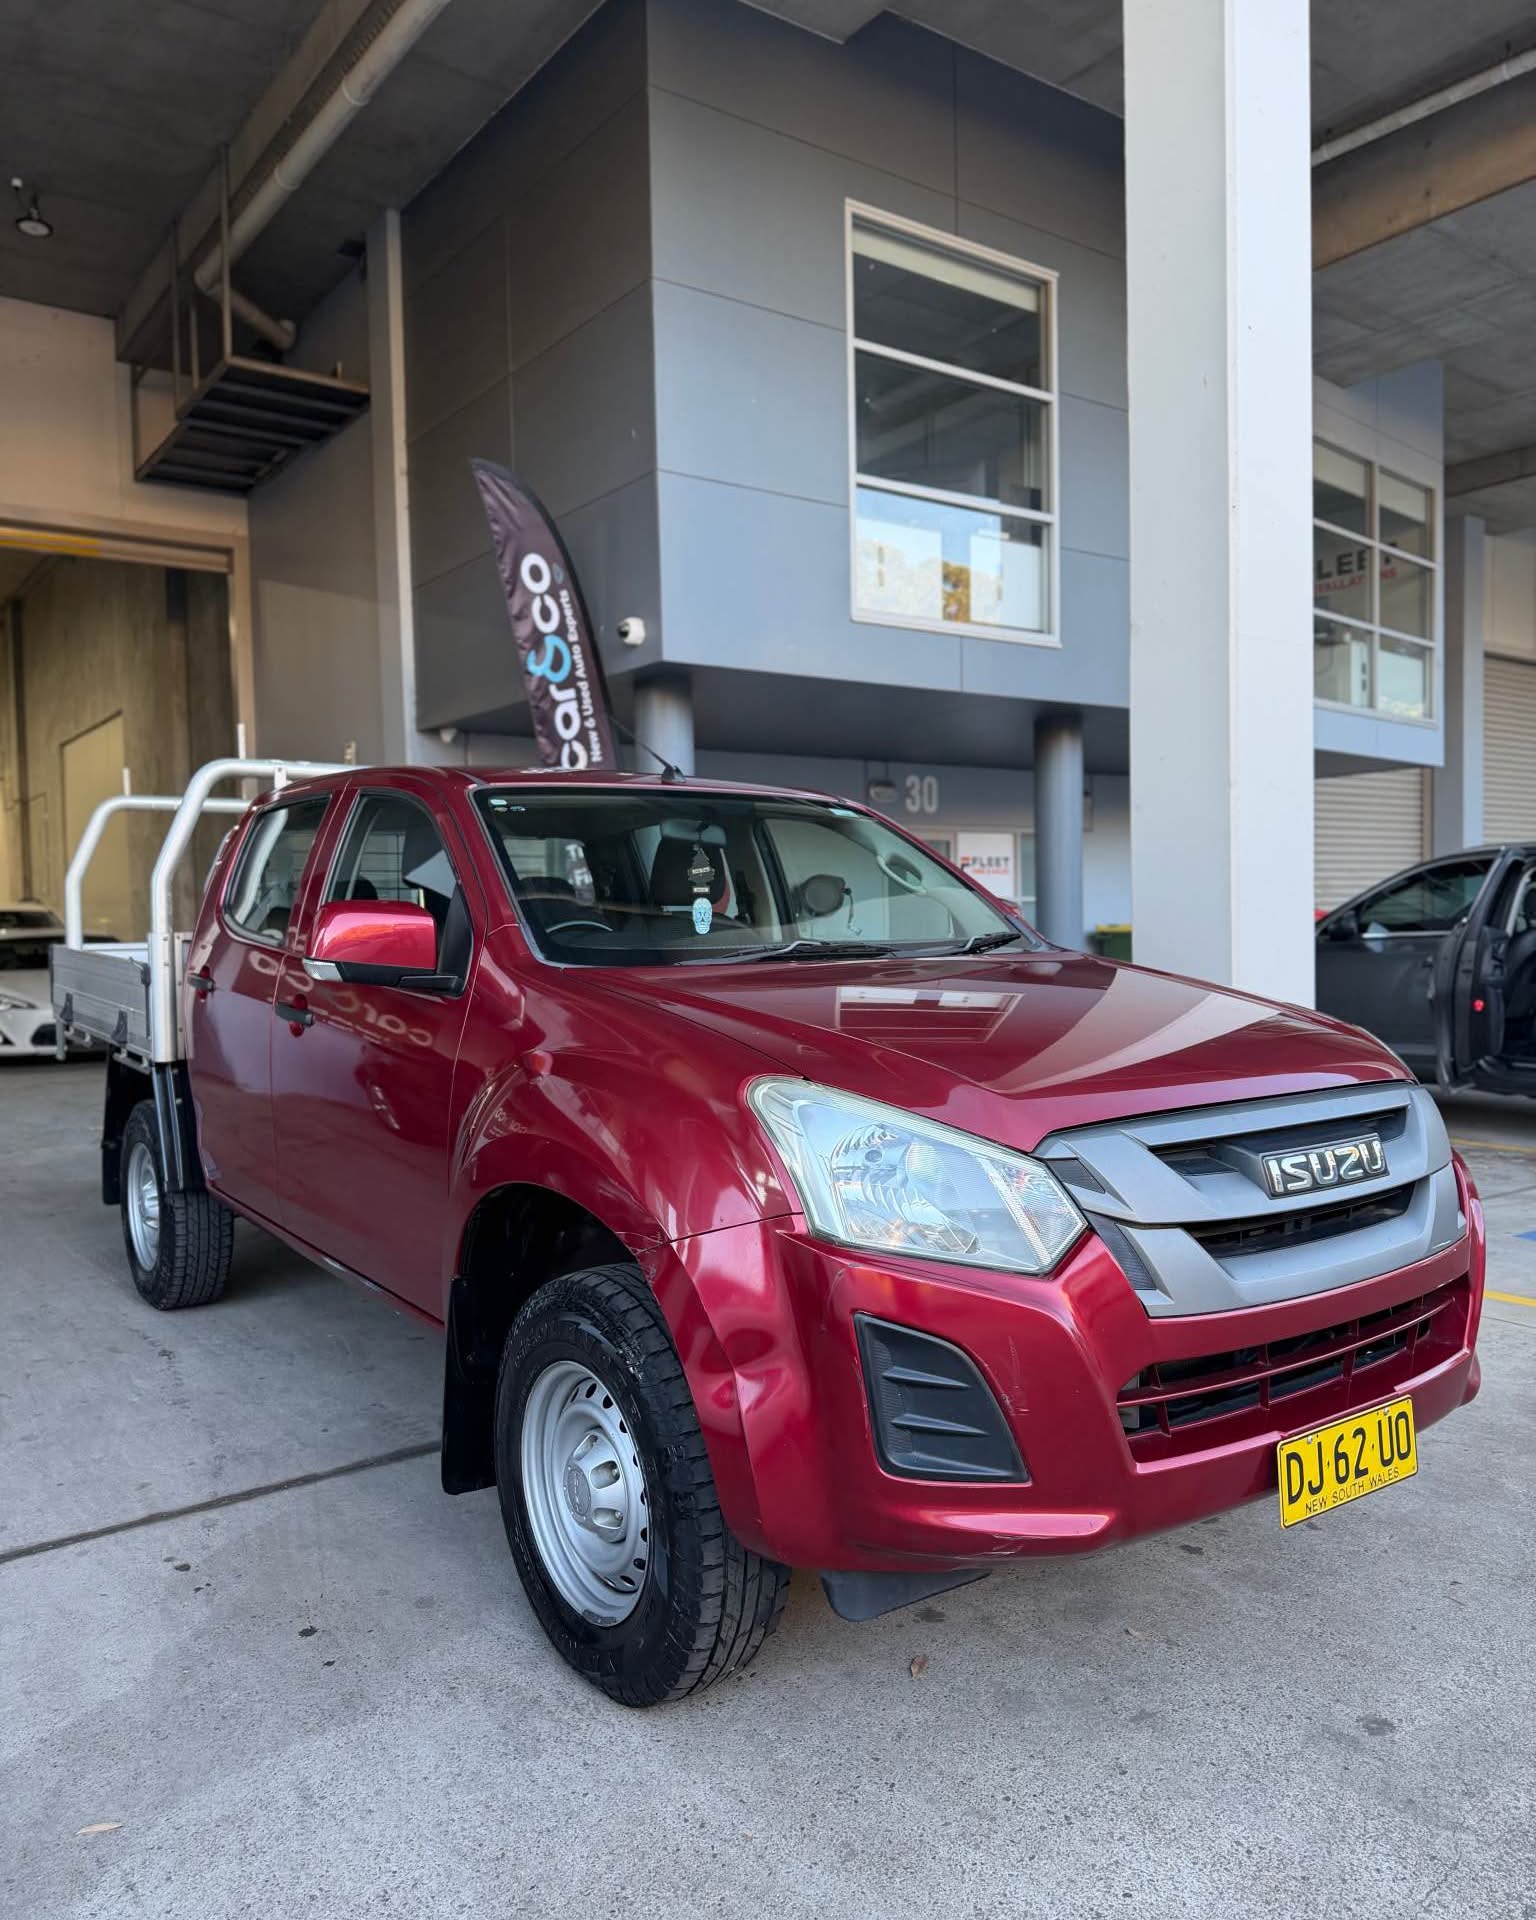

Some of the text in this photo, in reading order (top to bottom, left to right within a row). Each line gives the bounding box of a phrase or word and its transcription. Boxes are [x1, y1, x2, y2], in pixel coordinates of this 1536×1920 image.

[559, 589, 579, 643] Experts
[520, 552, 588, 769] car&co
[571, 643, 587, 679] Auto
[576, 681, 593, 716] Used
[588, 731, 603, 762] New
[905, 775, 938, 813] 30
[972, 856, 1010, 868] FLEET
[1267, 1140, 1386, 1193] ISUZU
[1305, 1466, 1400, 1515] NEW SOUTH WALES
